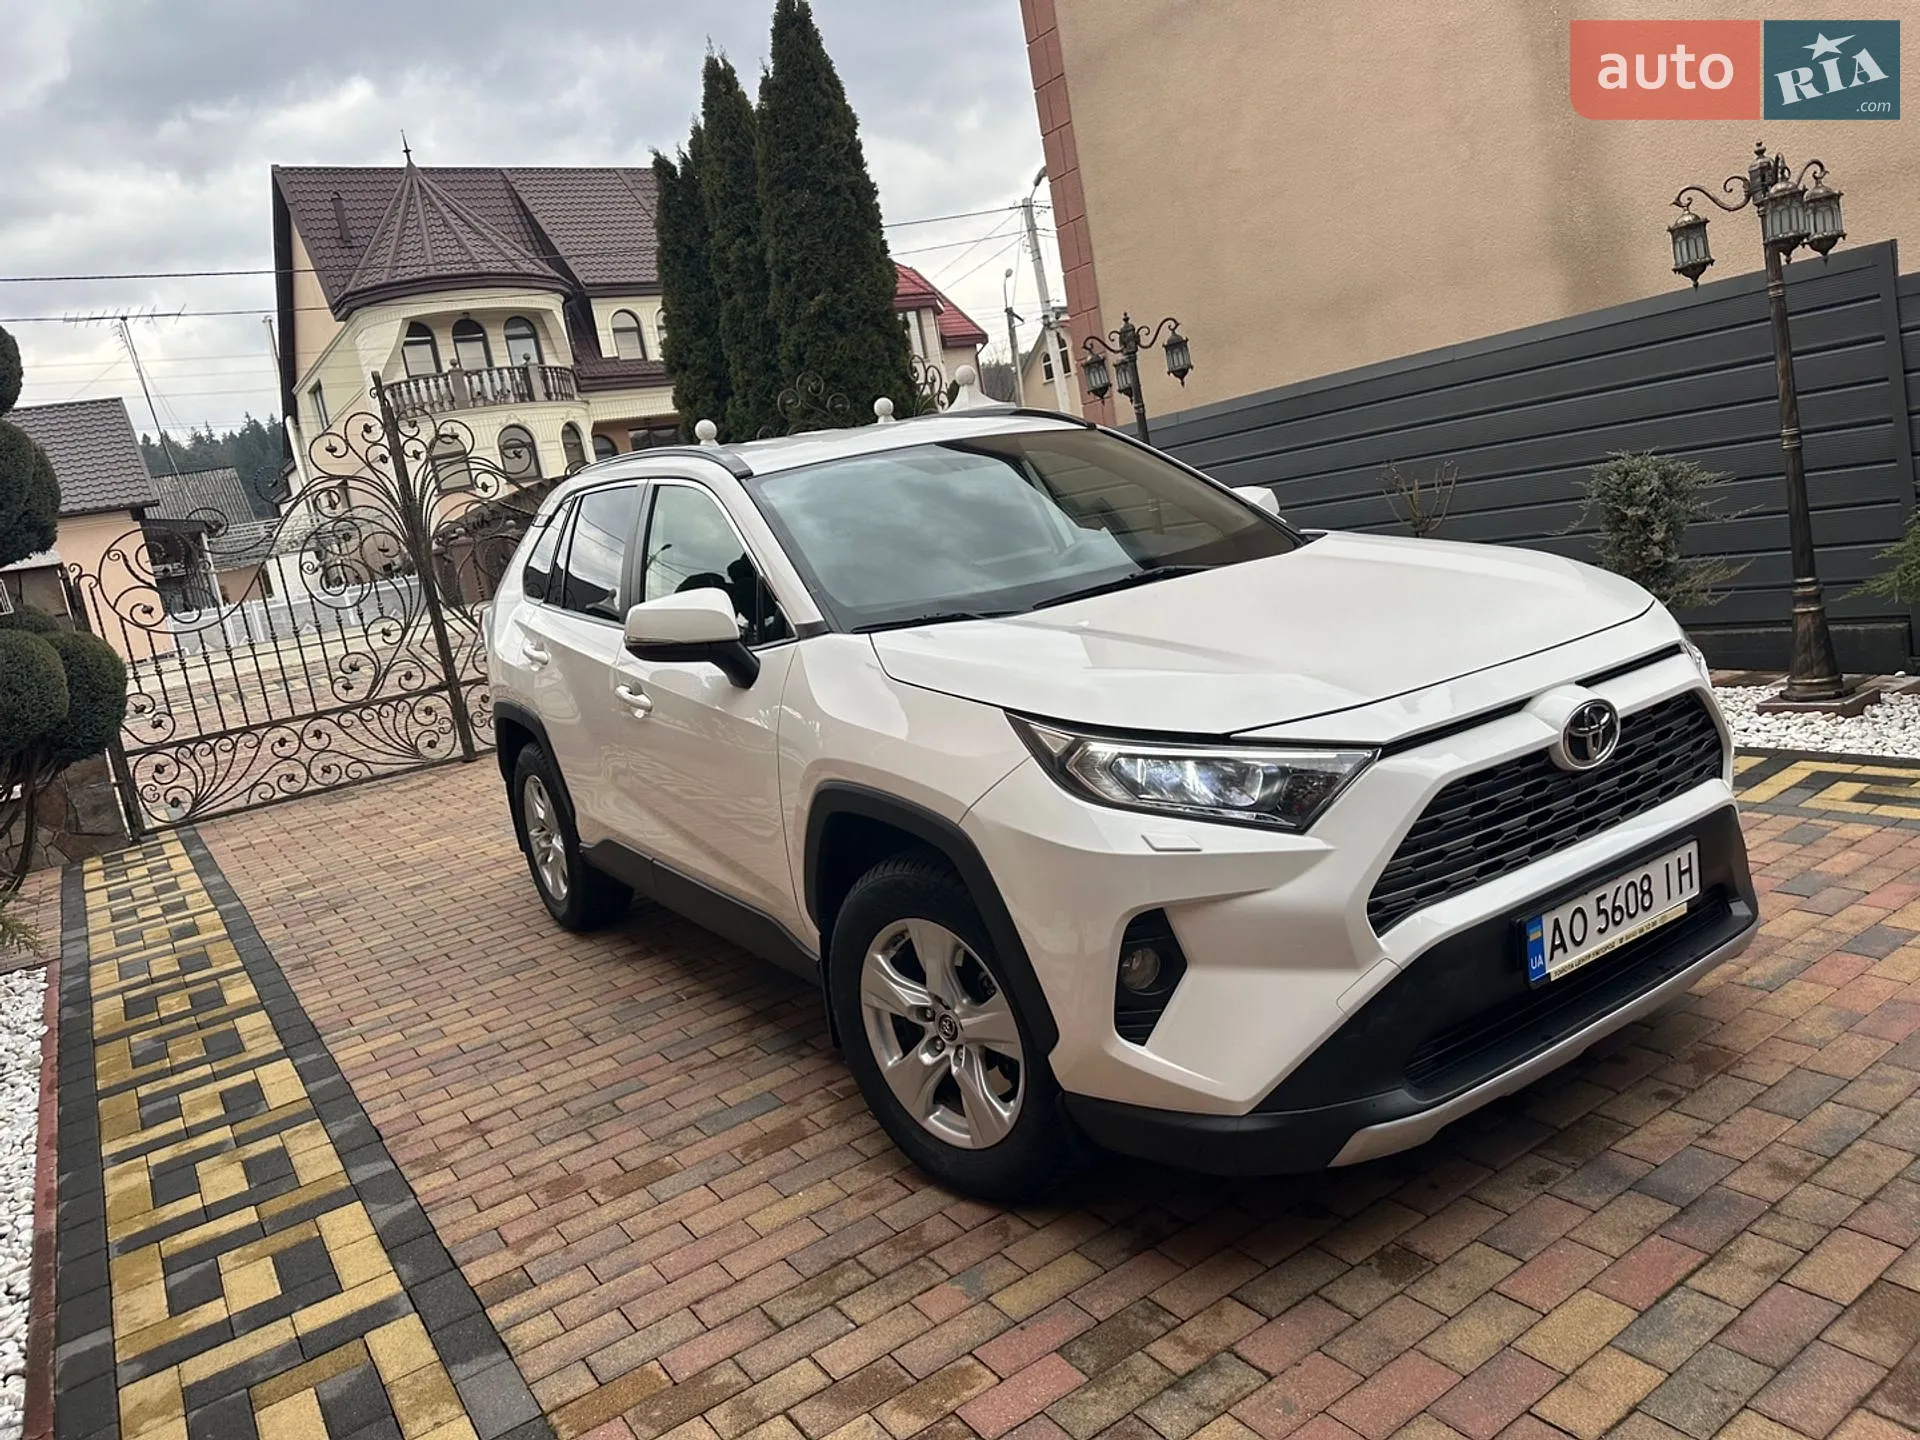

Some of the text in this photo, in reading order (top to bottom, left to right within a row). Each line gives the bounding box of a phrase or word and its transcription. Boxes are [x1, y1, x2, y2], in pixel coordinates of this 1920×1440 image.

[1550, 906, 1588, 962] AO
[1596, 873, 1654, 934] 5608
[1664, 851, 1694, 901] IH
[1530, 955, 1544, 971] UA
